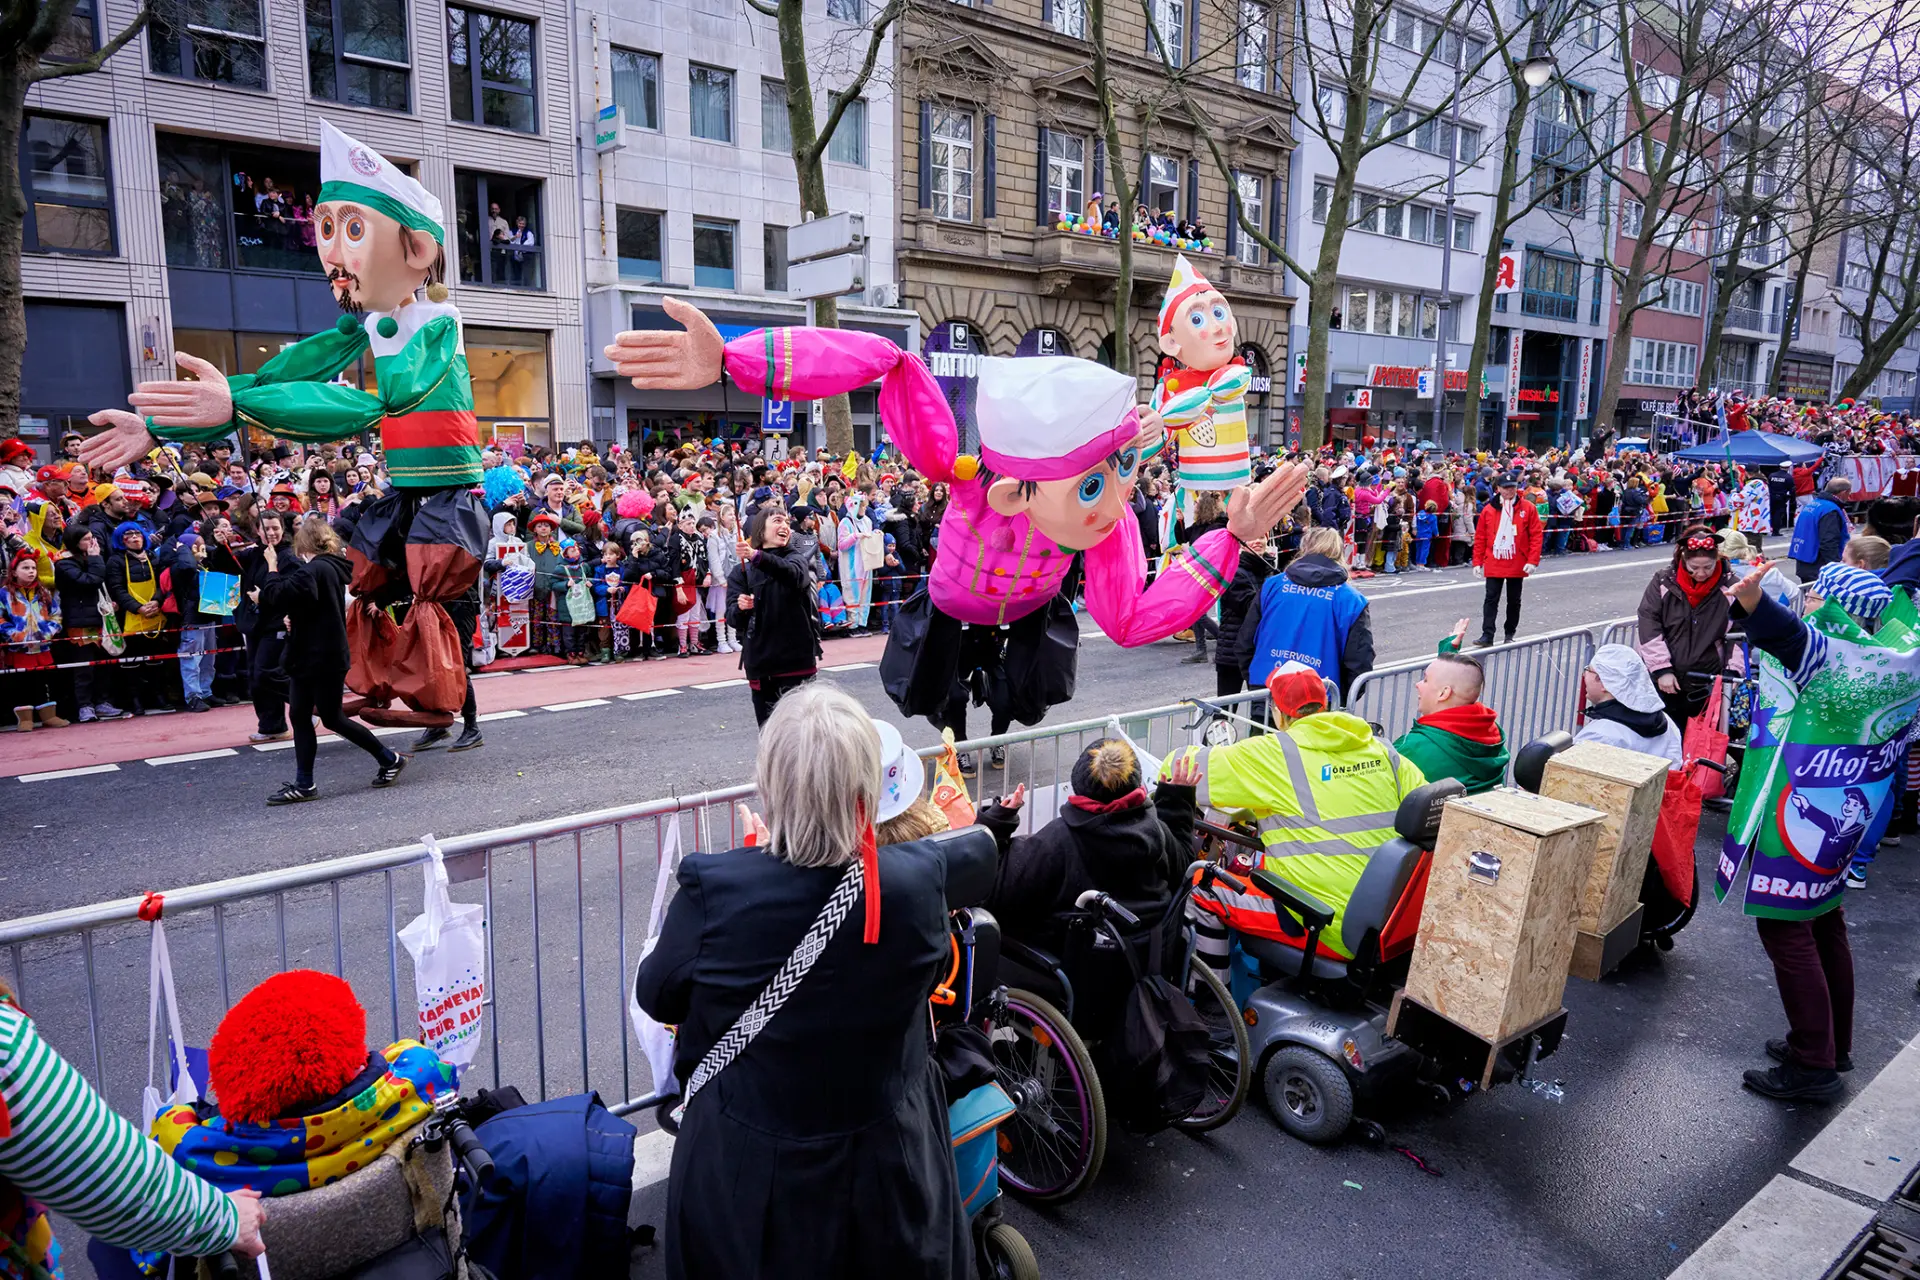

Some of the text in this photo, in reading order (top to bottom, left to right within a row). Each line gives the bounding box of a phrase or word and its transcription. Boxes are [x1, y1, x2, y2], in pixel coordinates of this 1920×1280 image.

[1372, 365, 1419, 389] APOTHEK
[1281, 583, 1335, 601] SERVICE
[1270, 648, 1322, 668] SUPERVISOR
[427, 1017, 455, 1041] FÜR
[1308, 1020, 1339, 1034] M63
